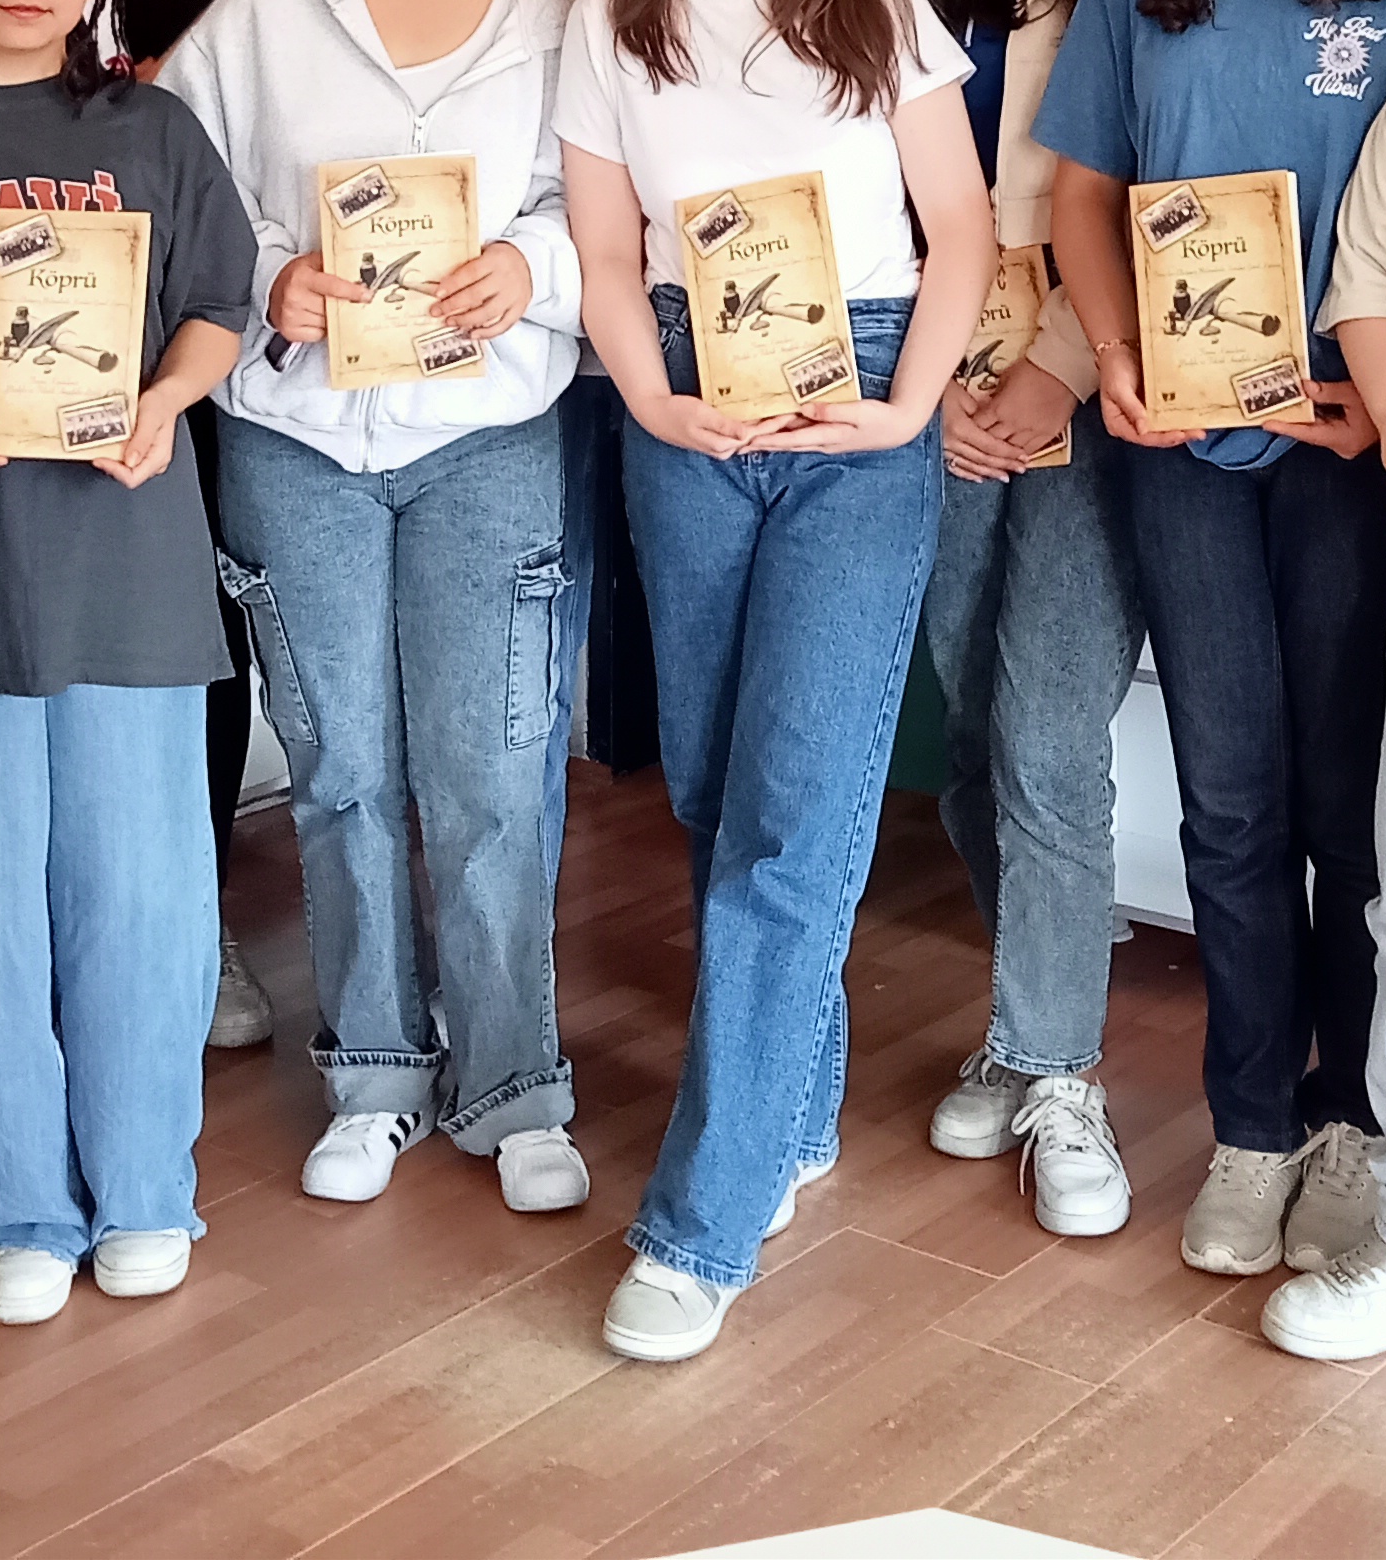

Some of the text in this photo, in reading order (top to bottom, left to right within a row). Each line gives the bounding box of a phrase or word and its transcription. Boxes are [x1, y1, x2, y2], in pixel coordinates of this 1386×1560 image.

[1303, 71, 1373, 101] Vibes!
[369, 214, 434, 238] Köprü
[727, 234, 790, 263] Köprü
[1180, 235, 1248, 262] Köprü
[28, 268, 98, 293] Köprü
